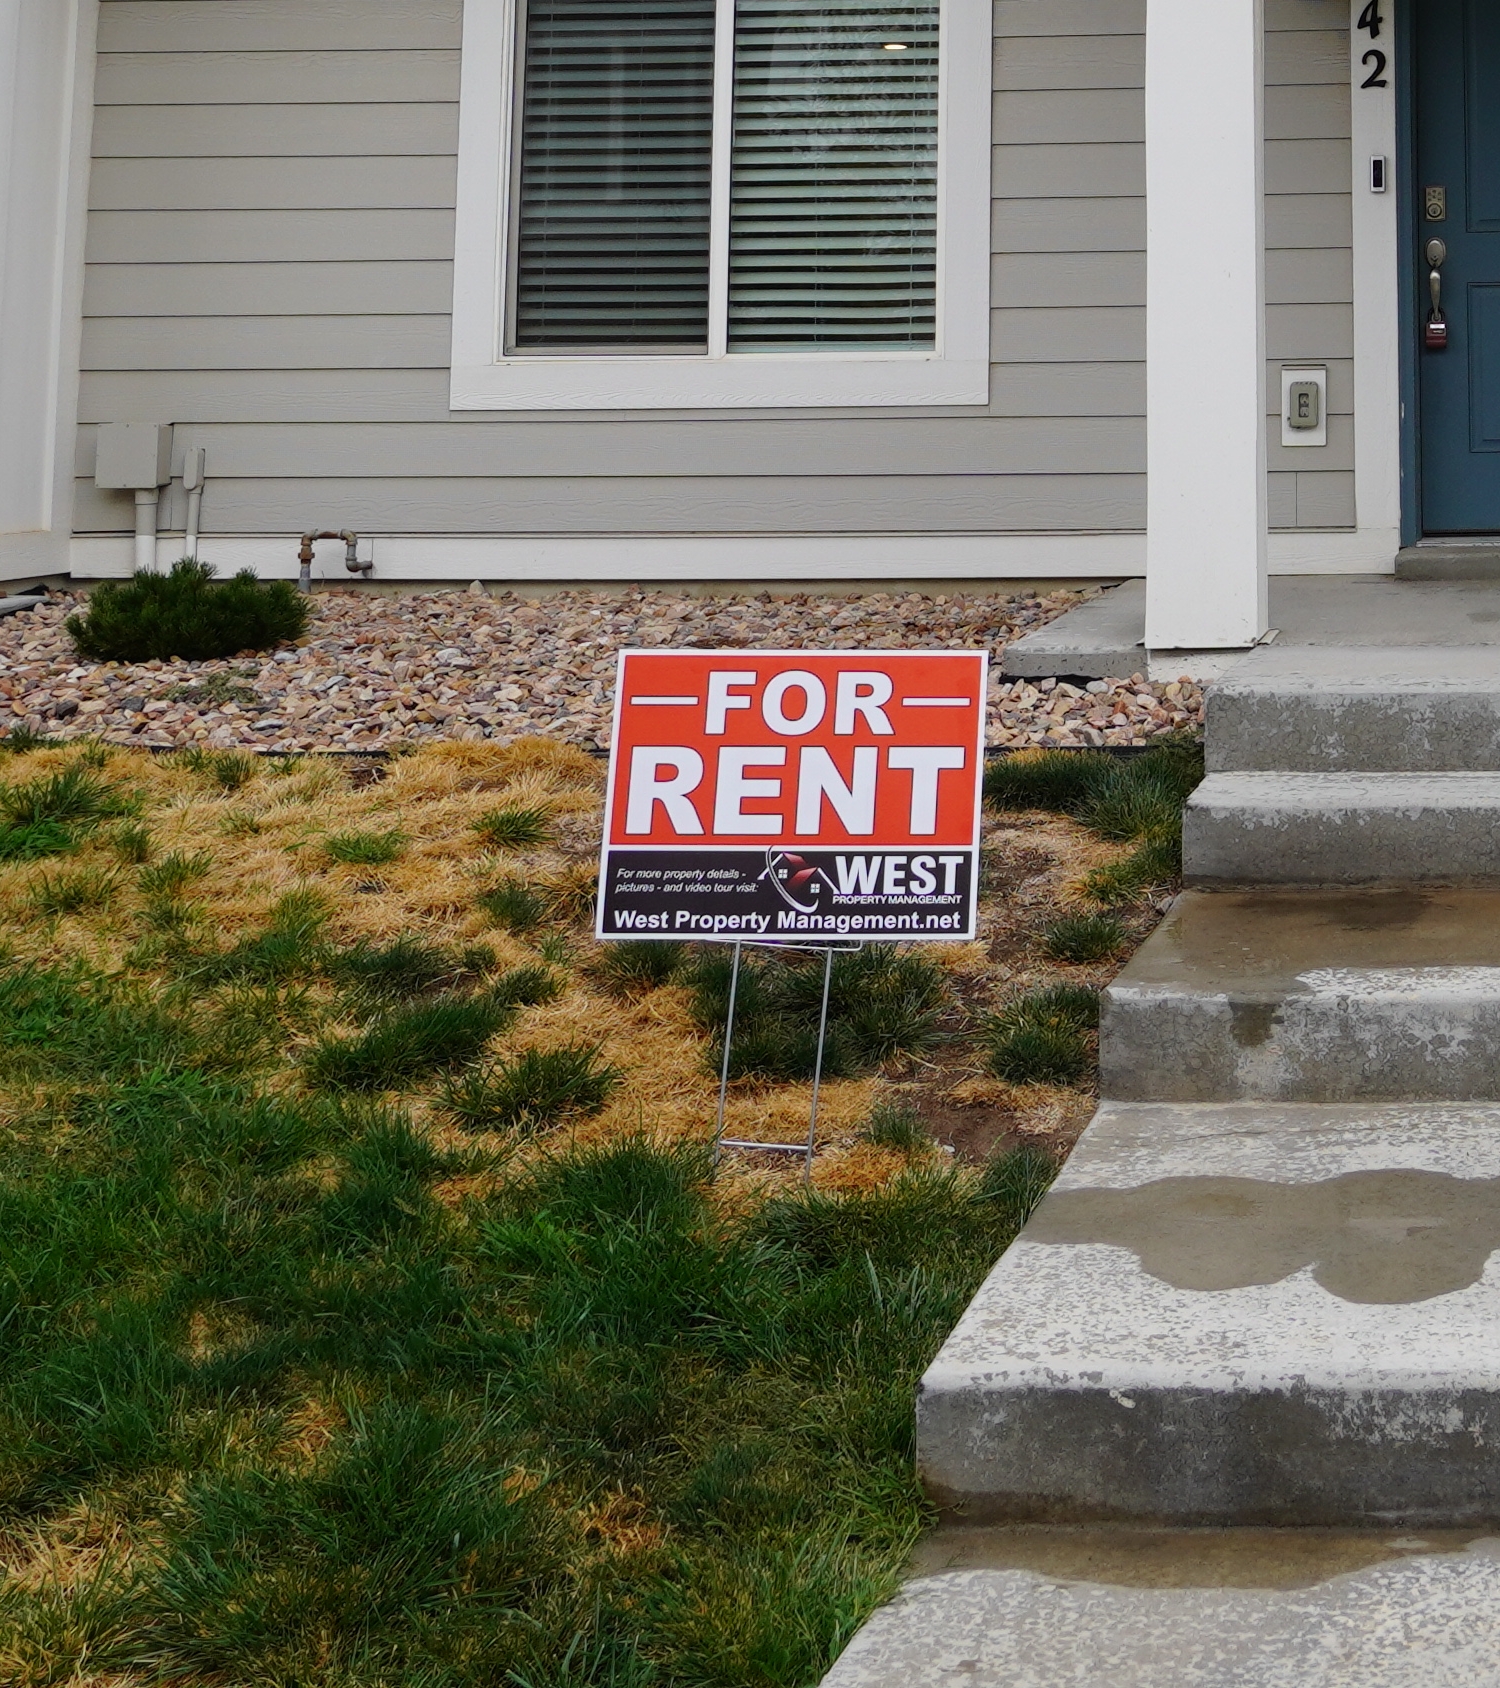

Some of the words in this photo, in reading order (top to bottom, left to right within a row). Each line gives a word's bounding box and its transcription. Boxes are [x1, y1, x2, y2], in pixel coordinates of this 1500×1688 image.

[704, 669, 896, 736] FOR
[625, 745, 967, 836] RENT
[616, 868, 635, 879] For
[636, 870, 661, 879] more
[663, 870, 706, 881] property
[707, 868, 740, 879] details
[835, 855, 965, 895] WEST
[615, 882, 655, 894] pictures
[663, 882, 683, 893] and
[685, 882, 712, 893] video
[714, 883, 734, 893] tour
[736, 882, 760, 893] visit:
[832, 895, 888, 905] PROPERTY
[888, 895, 963, 905] MANAGEMENT
[613, 910, 670, 929] West
[675, 910, 771, 933] Property
[777, 911, 962, 933] Management.net
